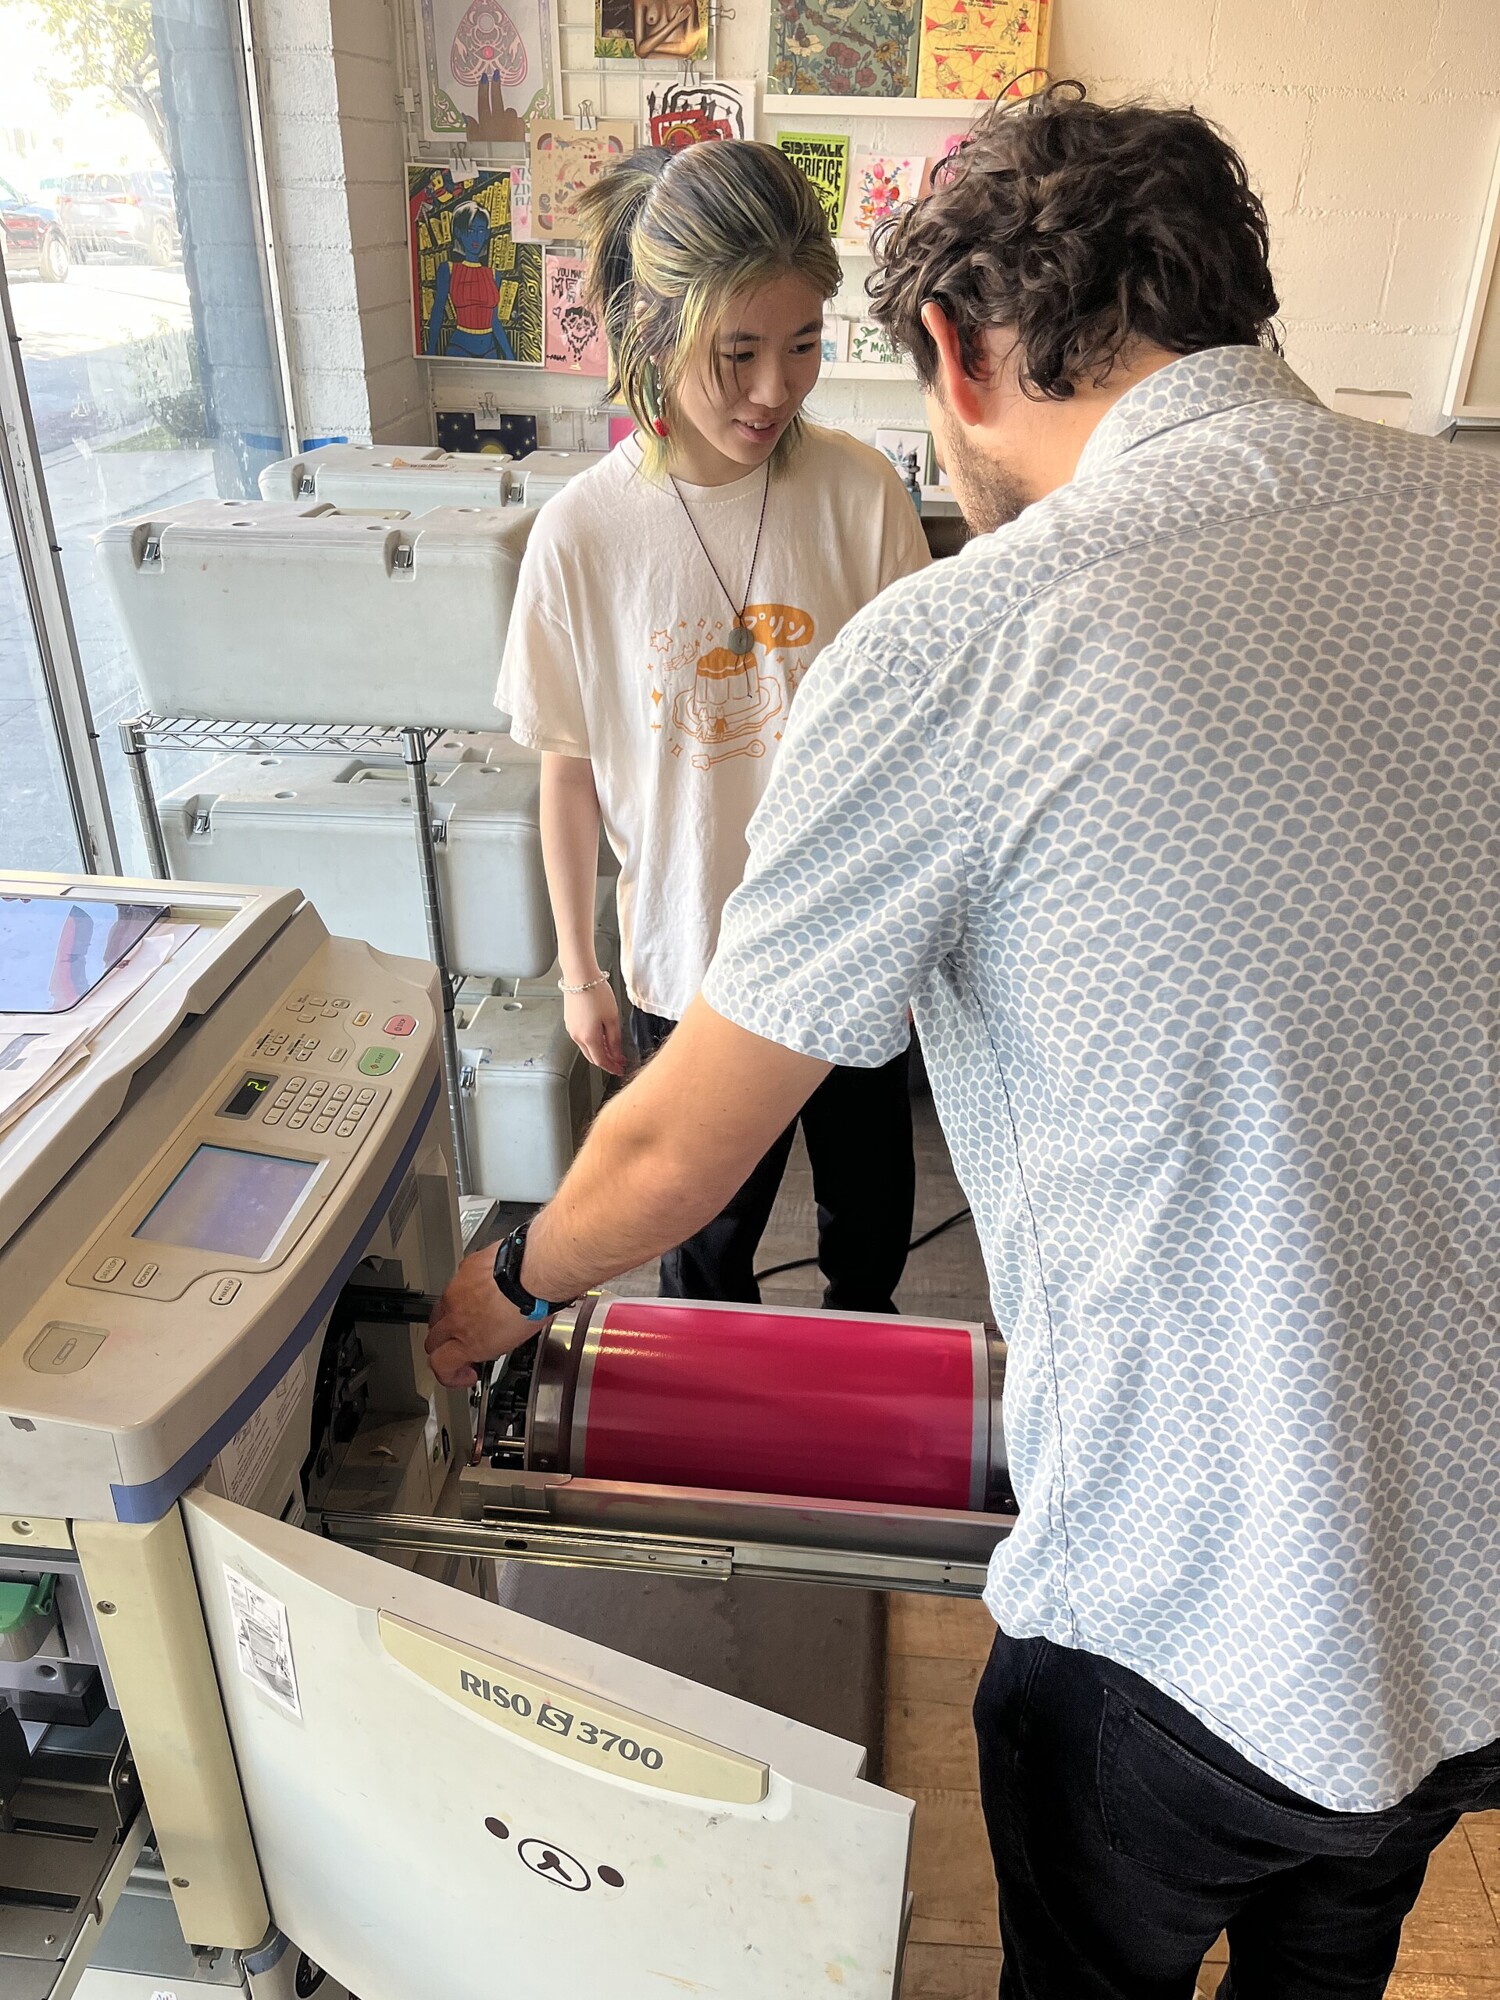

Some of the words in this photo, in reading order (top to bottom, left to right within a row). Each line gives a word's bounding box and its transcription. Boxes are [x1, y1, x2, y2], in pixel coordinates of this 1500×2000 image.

[781, 141, 845, 158] SIDEWALK
[788, 156, 843, 192] ACRIFICE
[880, 353, 902, 364] HIGH
[744, 612, 806, 641] プリン
[375, 1052, 385, 1064] START
[460, 1669, 532, 1717] RISO
[539, 1705, 571, 1734] S
[576, 1721, 664, 1770] 3700
